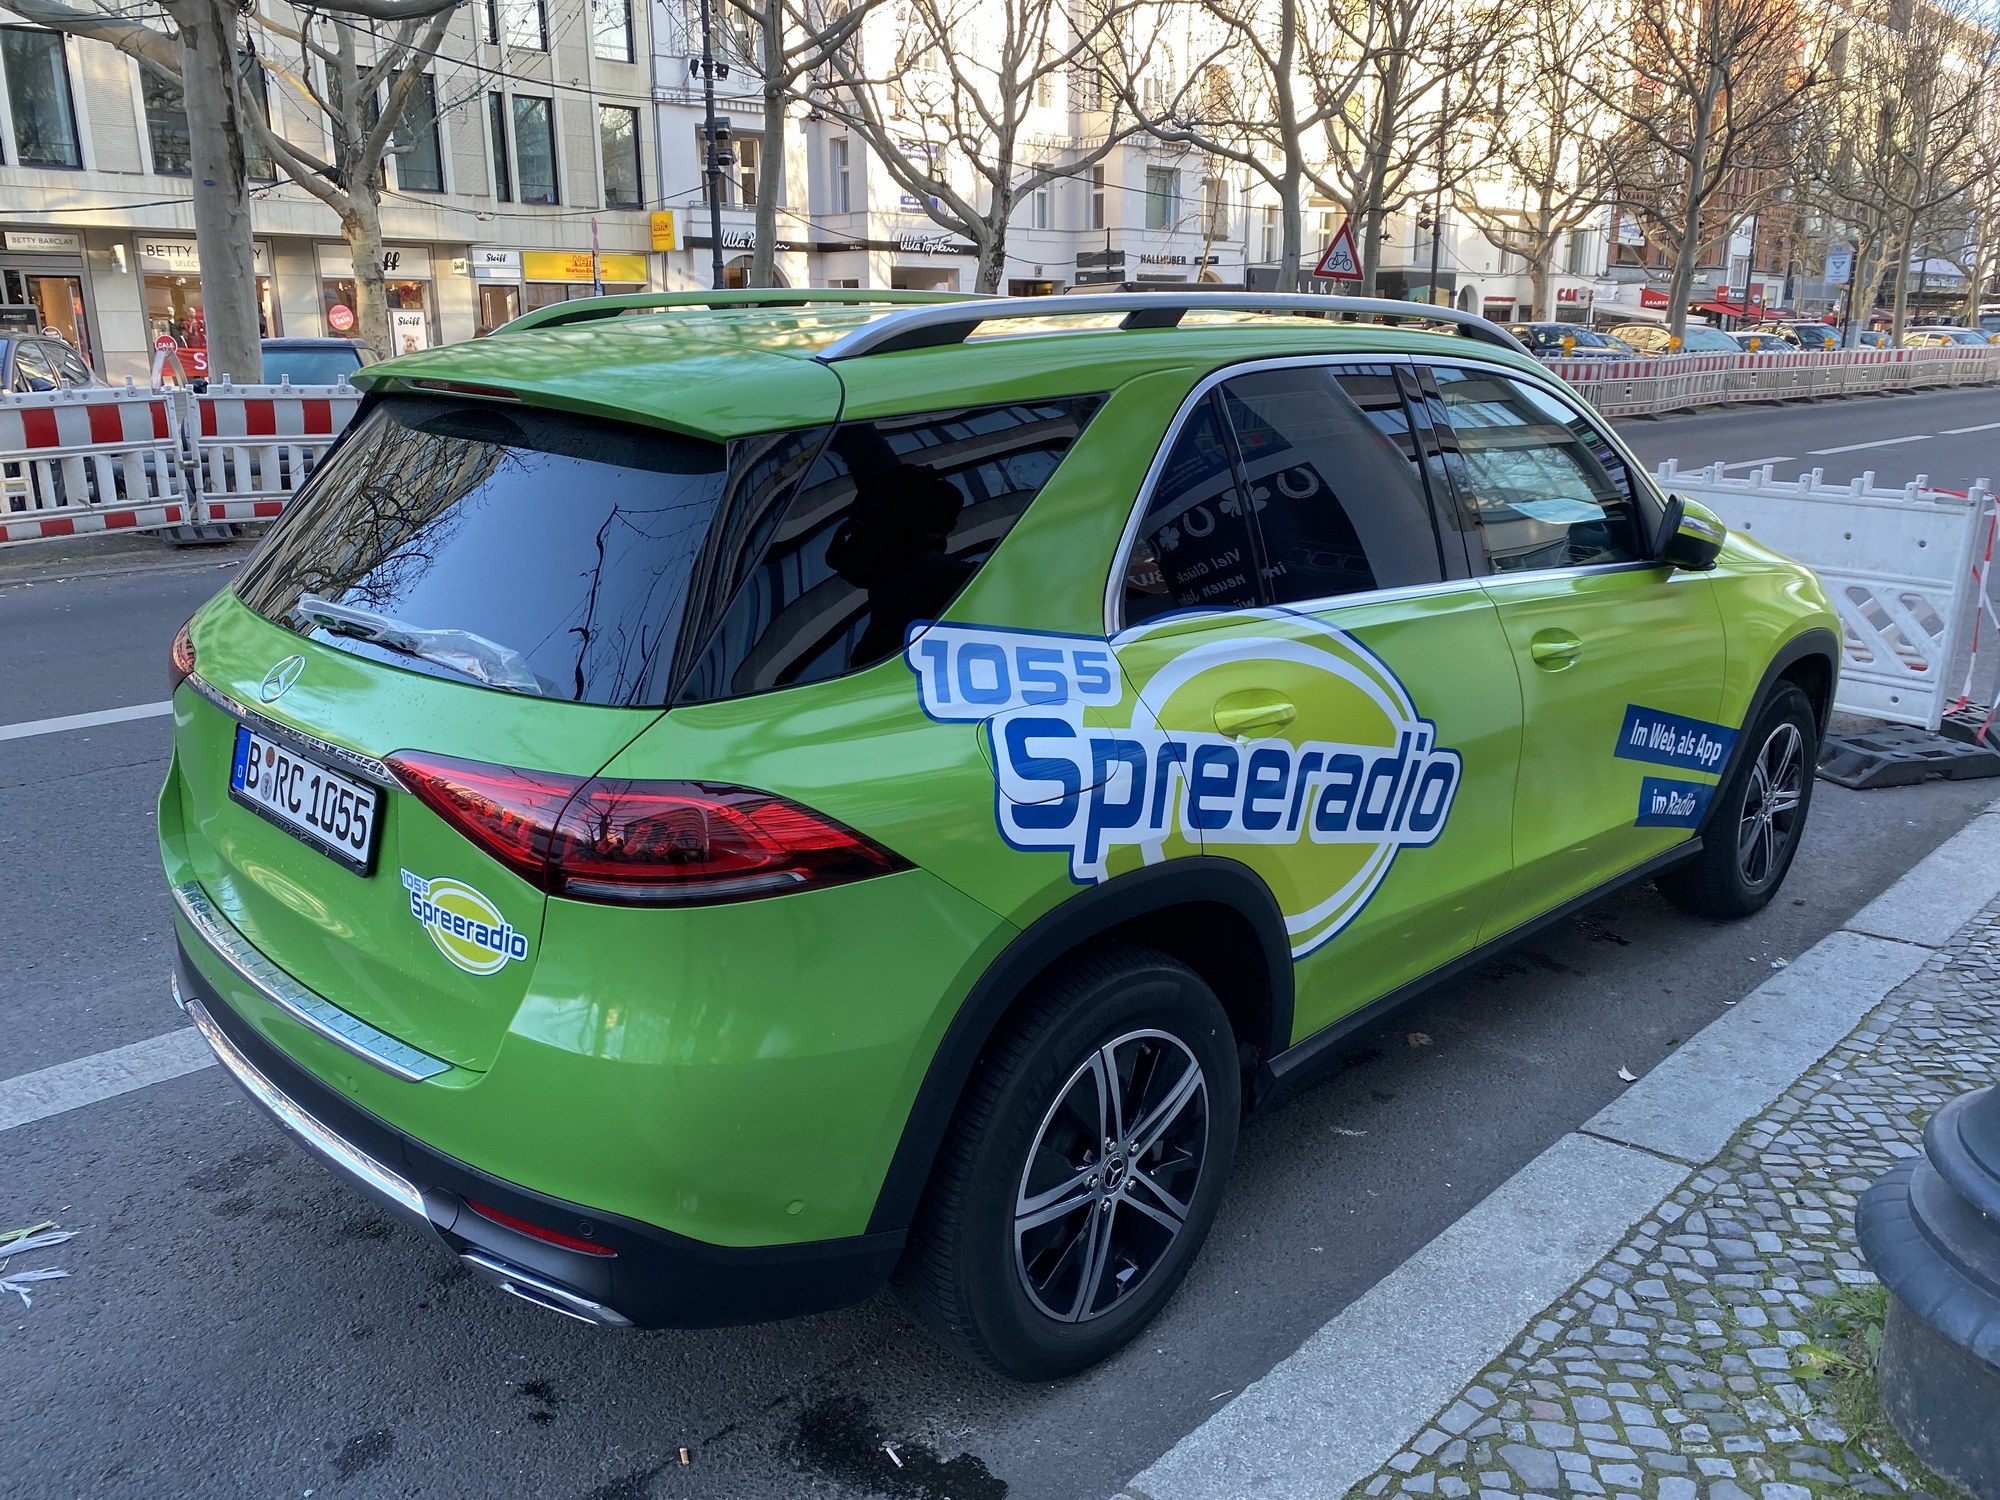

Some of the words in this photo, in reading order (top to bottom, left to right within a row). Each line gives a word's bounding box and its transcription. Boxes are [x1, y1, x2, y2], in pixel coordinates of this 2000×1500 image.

[11, 236, 37, 244] BETTY
[146, 245, 192, 257] BETTY
[900, 236, 921, 251] Ulla
[922, 238, 959, 257] Popken
[485, 253, 507, 263] Steiff
[1141, 254, 1187, 265] HALLHUBER
[334, 316, 351, 326] Sale
[398, 317, 420, 326] Steiff
[921, 638, 1112, 707] 1055
[1629, 719, 1648, 746] Im
[1649, 722, 1675, 757] Web,
[1677, 730, 1696, 756] als
[1695, 733, 1722, 766] App
[246, 740, 262, 789] B
[273, 755, 304, 813] RC
[305, 774, 370, 849] 1055
[1004, 716, 1456, 864] Spreeradio
[1651, 788, 1667, 814] im
[1667, 791, 1696, 816] Radio
[402, 870, 429, 893] 1055
[412, 893, 526, 958] Spreeradio
